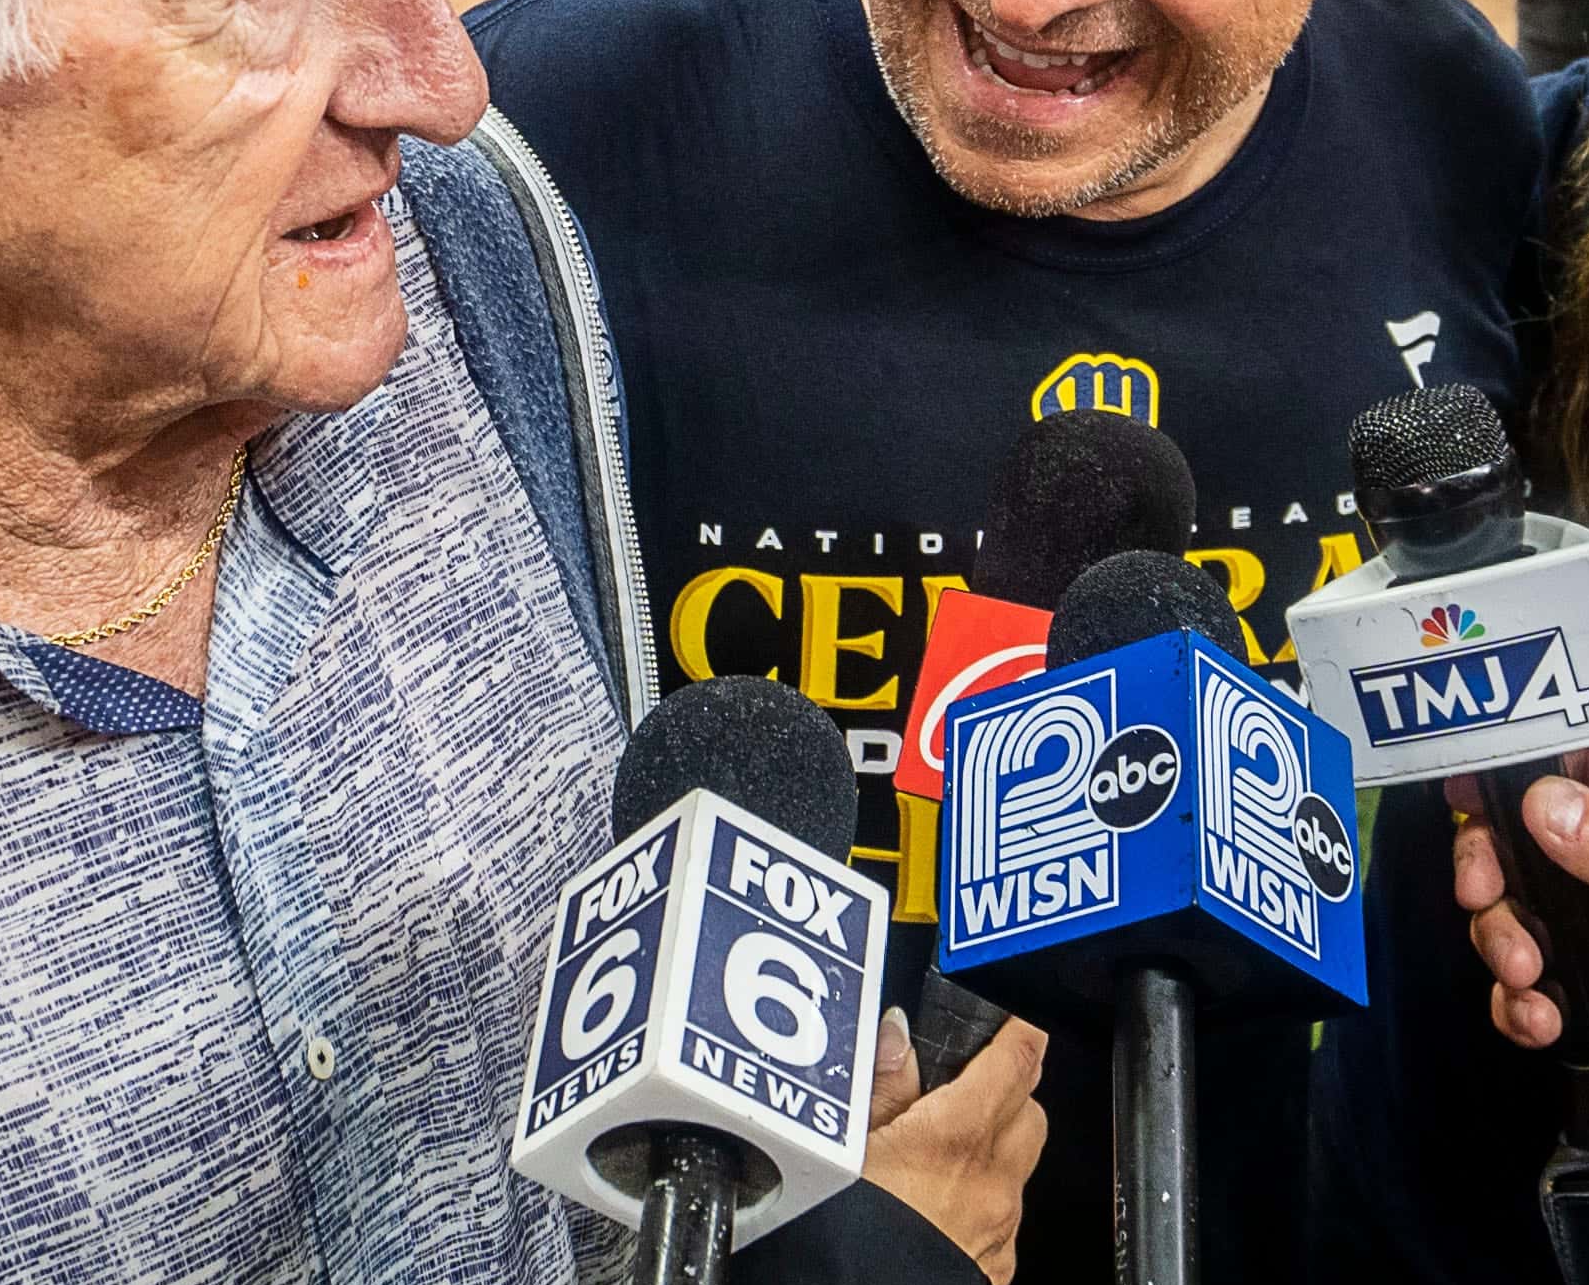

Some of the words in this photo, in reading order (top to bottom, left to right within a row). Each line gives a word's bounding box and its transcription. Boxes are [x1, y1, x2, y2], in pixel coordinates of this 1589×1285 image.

[1088, 750, 1177, 805] abc
[572, 834, 665, 946] FOX
[729, 835, 854, 953] FOX
[959, 848, 1110, 936] WISN
[1205, 834, 1312, 947] WISN
[1294, 817, 1352, 876] abc
[560, 928, 642, 1061] 6
[722, 931, 829, 1068] 6
[532, 1038, 639, 1133] NEWS
[691, 1037, 842, 1136] NEWS
